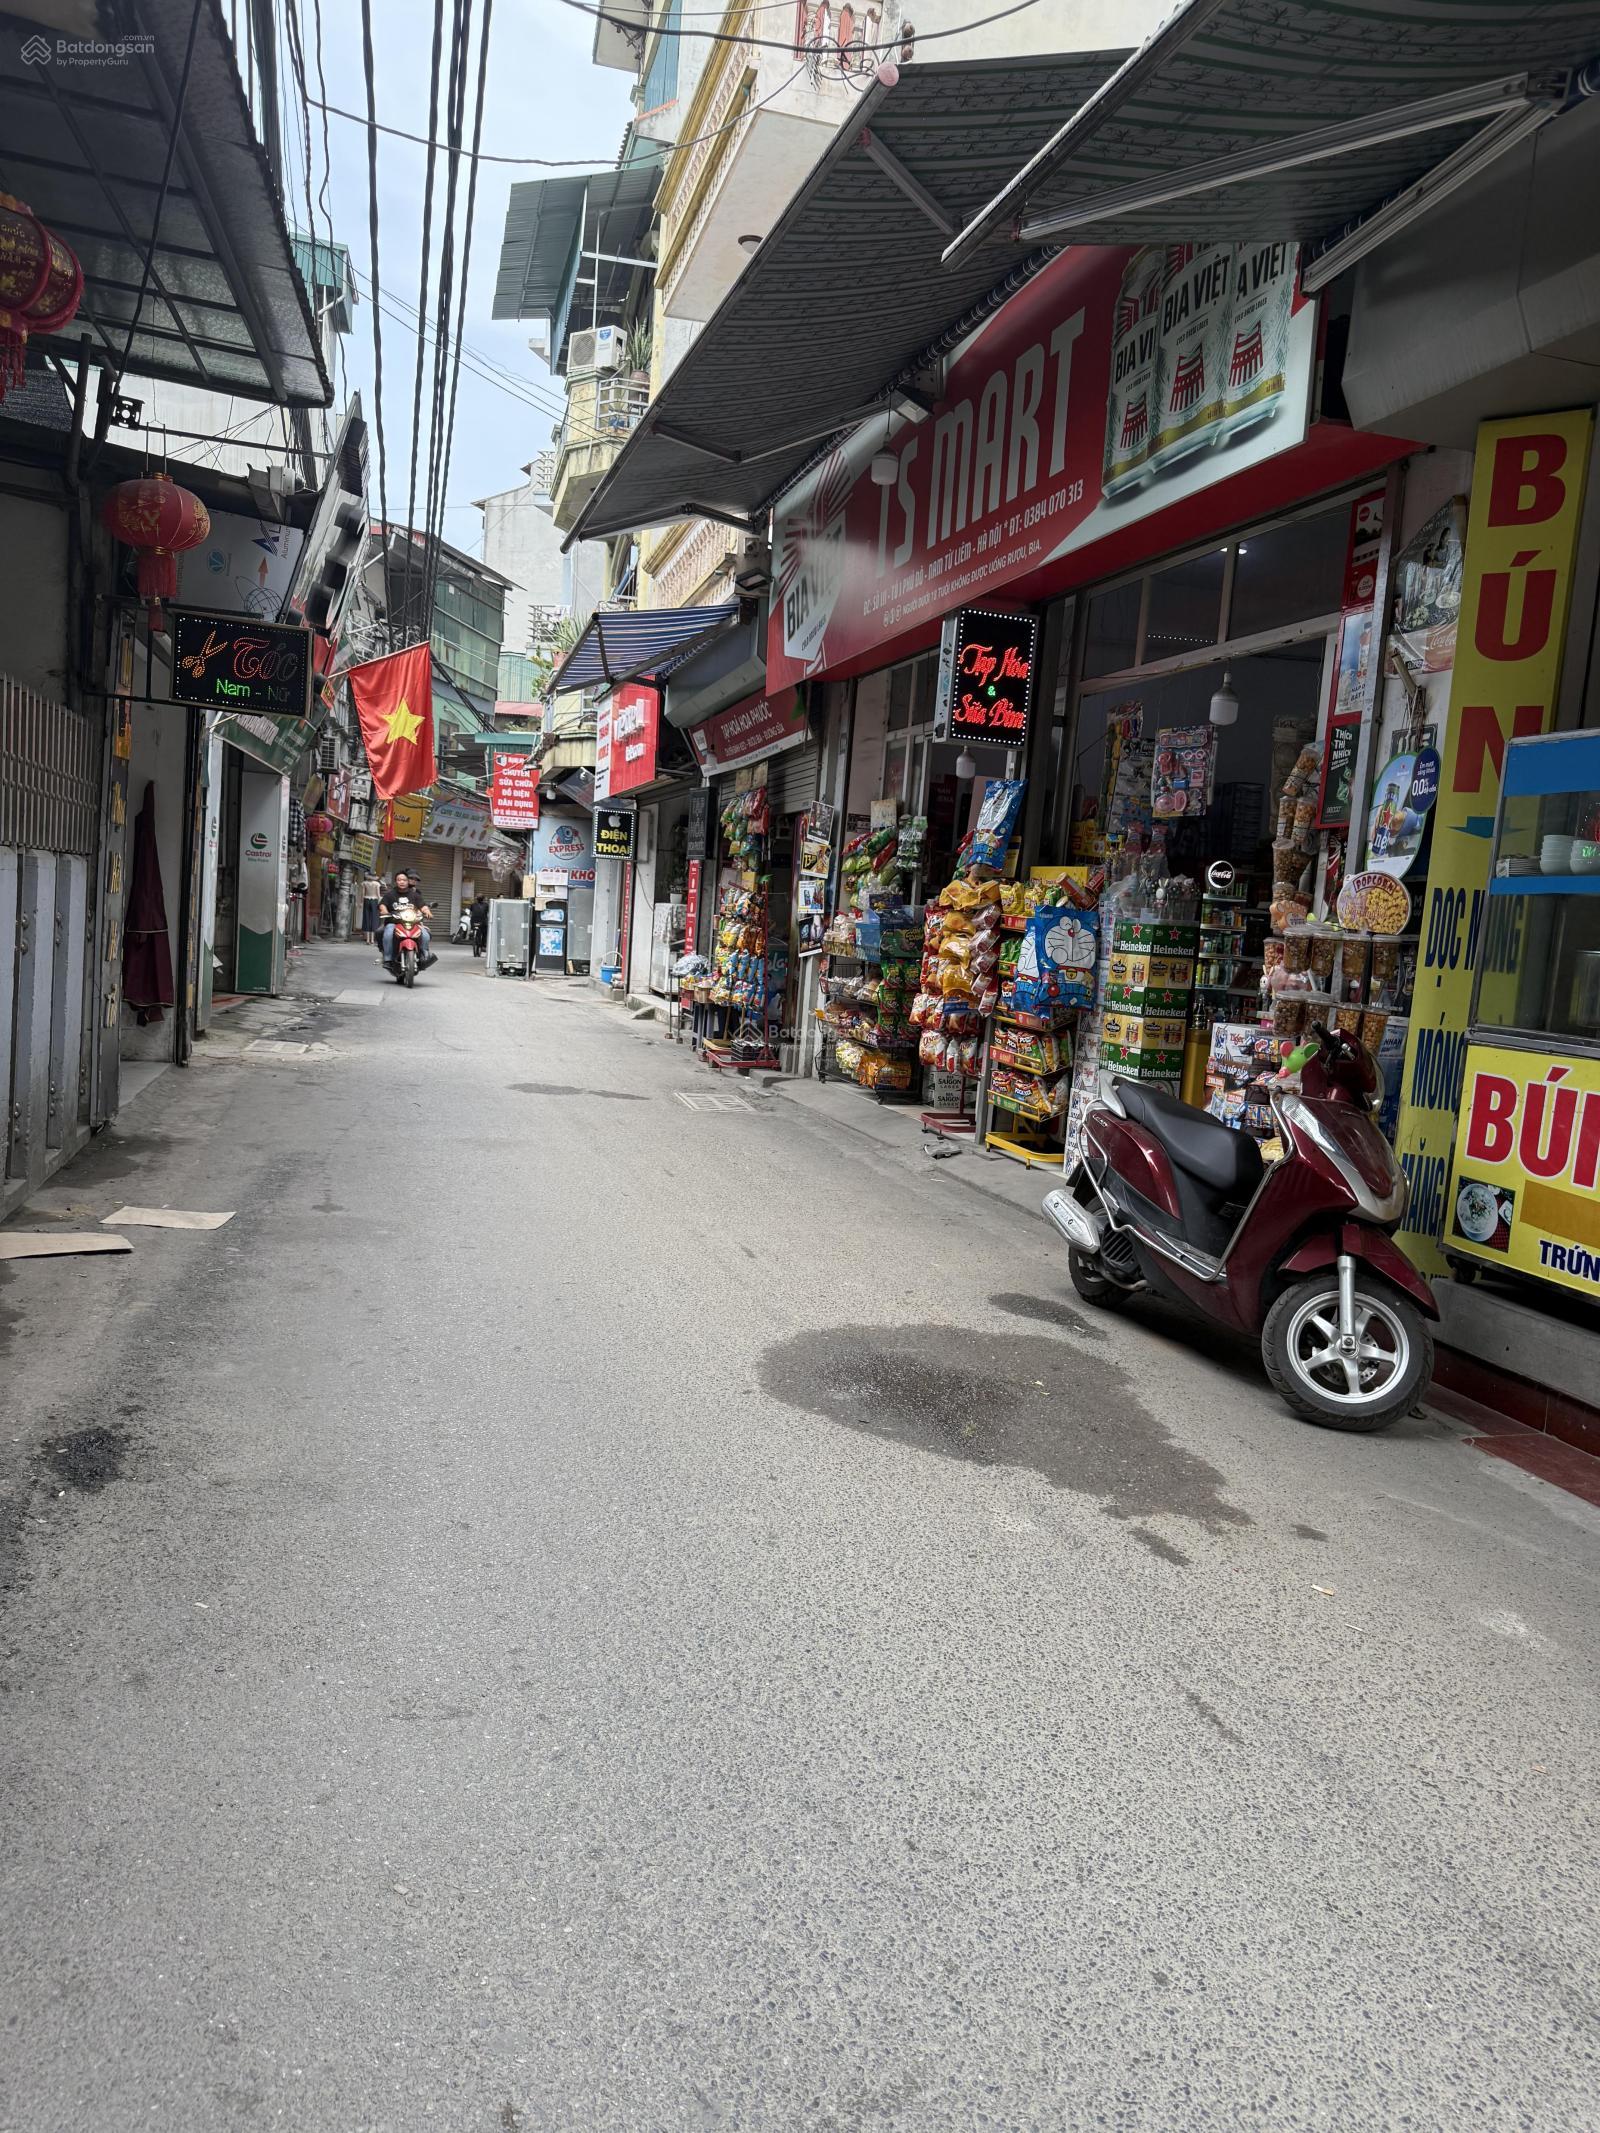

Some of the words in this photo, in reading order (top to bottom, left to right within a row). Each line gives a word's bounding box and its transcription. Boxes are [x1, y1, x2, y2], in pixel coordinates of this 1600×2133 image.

[1163, 297, 1189, 336] BIA
[1194, 254, 1230, 306] VIỆT
[1115, 349, 1136, 385] BIA
[926, 306, 1086, 550] MART
[928, 558, 943, 580] NAM
[954, 541, 972, 567] LIÊM
[977, 529, 988, 555] HÀ
[989, 522, 1002, 549] NỘI
[1024, 499, 1047, 529] 0384
[1049, 488, 1066, 516] 070
[1067, 479, 1084, 505] 313
[951, 570, 972, 590] KHÔNG
[971, 563, 989, 582] ĐƯỢC
[989, 555, 1007, 574] UỐNG
[787, 575, 810, 642] BIA
[1452, 433, 1568, 793] BÚN
[959, 643, 998, 687] Tạp
[993, 646, 1030, 683] Hóa
[216, 678, 251, 698] Nam
[268, 685, 290, 702] Nữ
[987, 685, 997, 697] &
[954, 694, 988, 725] Sữa
[600, 828, 628, 842] ĐIỆN
[245, 850, 272, 858] Castrol
[549, 843, 585, 854] EXPRESS
[596, 842, 632, 857] THOẠI
[1355, 876, 1397, 894] POPCORN
[1425, 887, 1466, 987] DỌC
[1120, 941, 1151, 953] Heineken
[1153, 944, 1196, 956] Heineken
[1111, 1000, 1143, 1015] Heineken
[1146, 1006, 1188, 1018] Heineken
[1108, 1060, 1140, 1077] Heineken
[1141, 1067, 1182, 1079] Heineken
